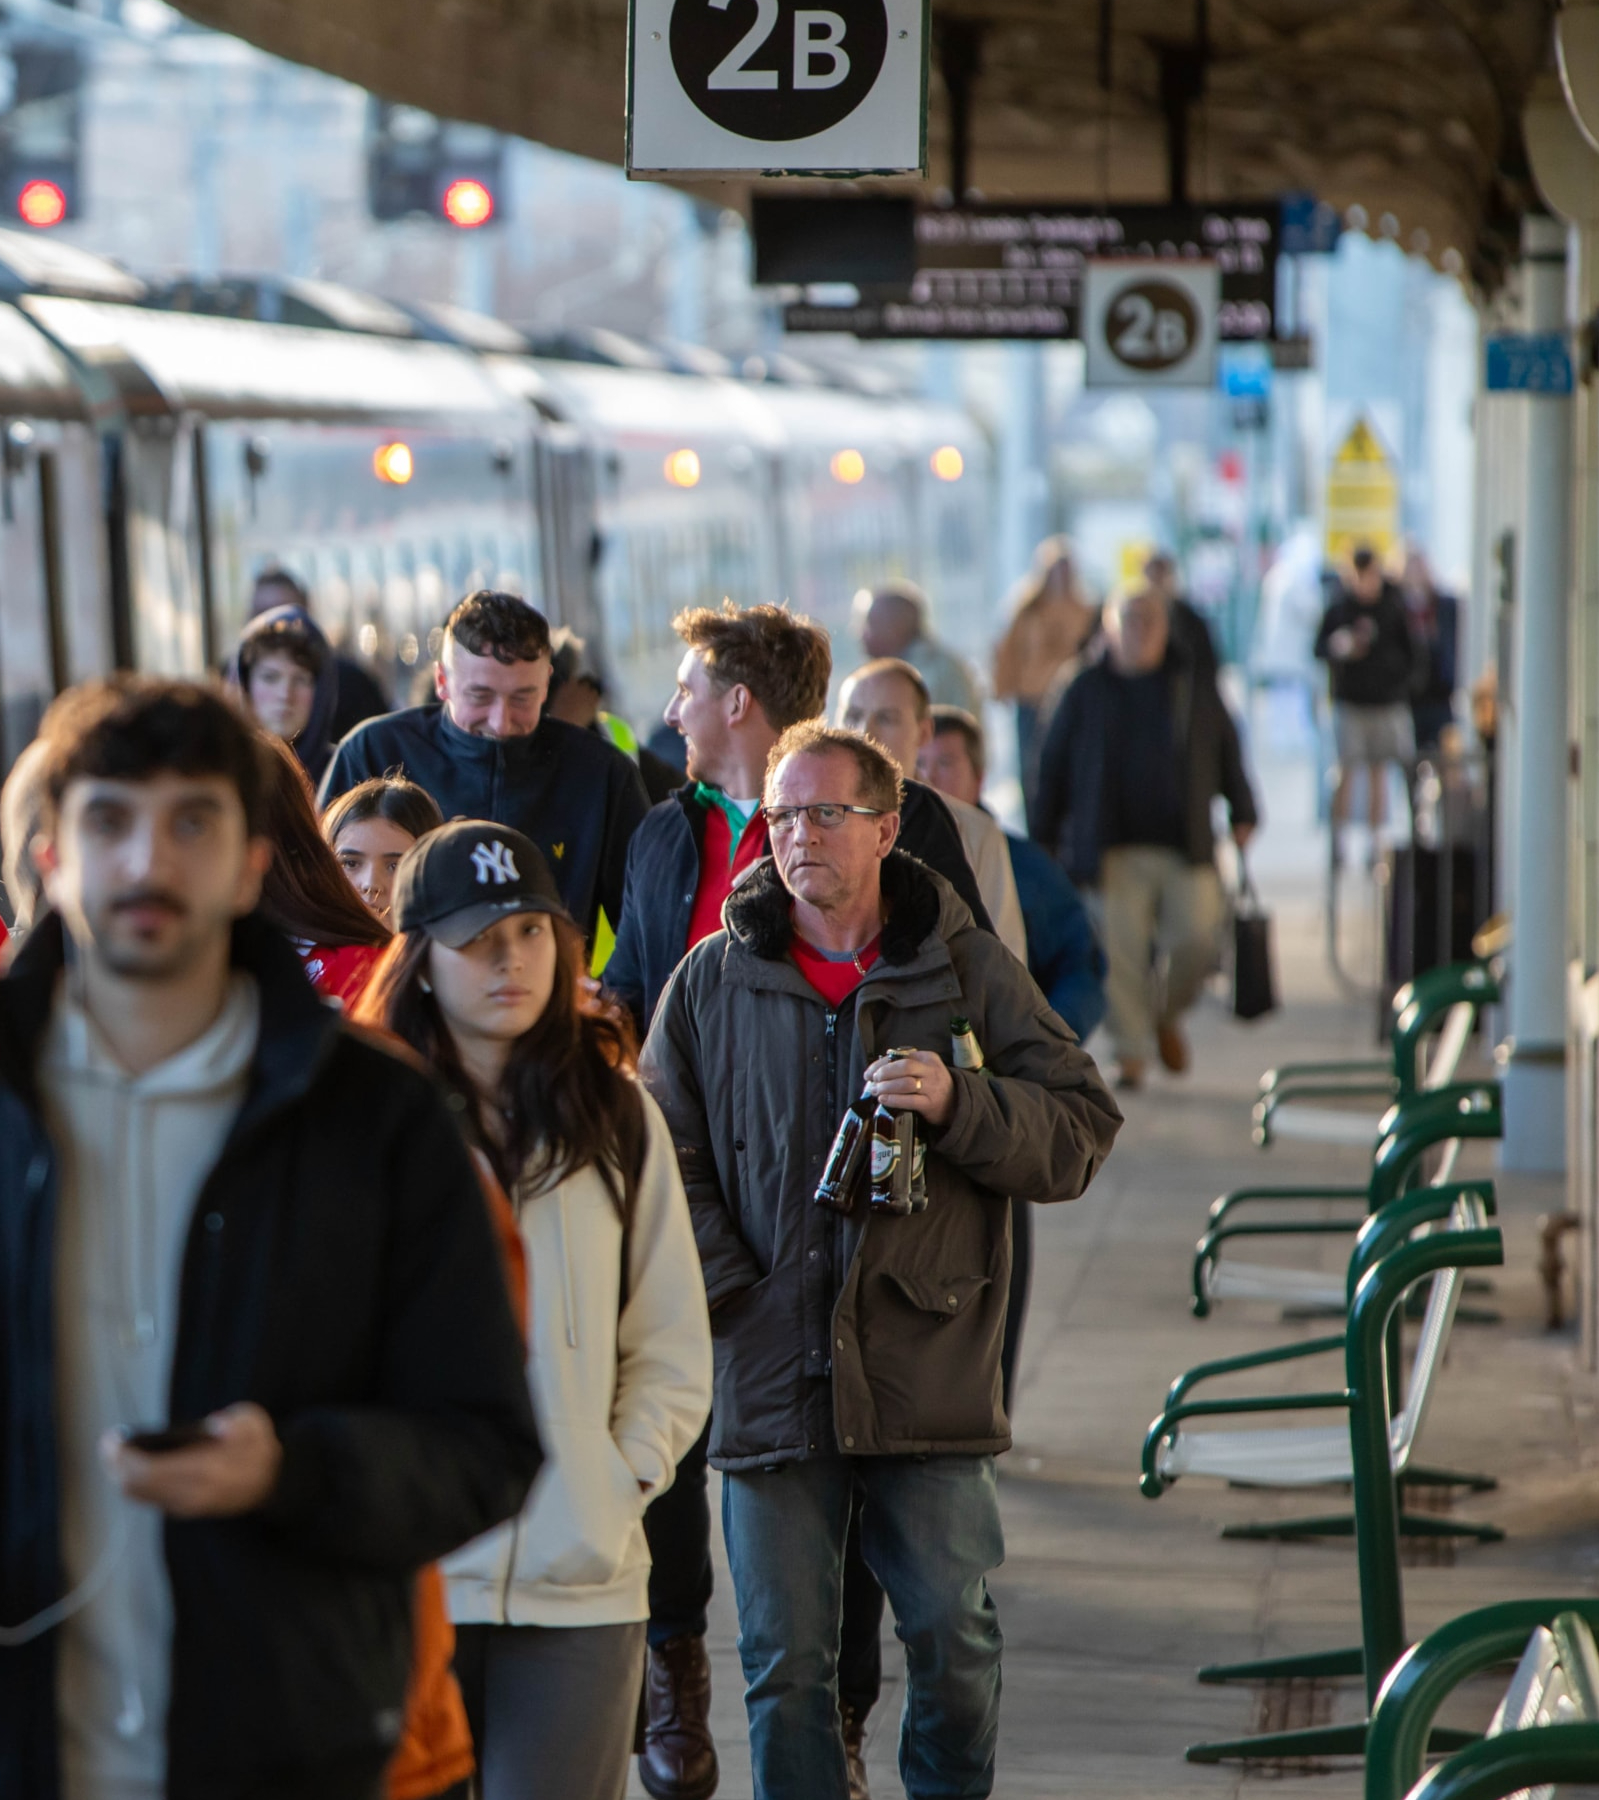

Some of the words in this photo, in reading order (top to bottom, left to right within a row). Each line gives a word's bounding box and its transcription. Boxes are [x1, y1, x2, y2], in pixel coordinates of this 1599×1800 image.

[707, 0, 851, 90] 2B
[1114, 294, 1188, 359] 2B
[469, 840, 520, 884] NY
